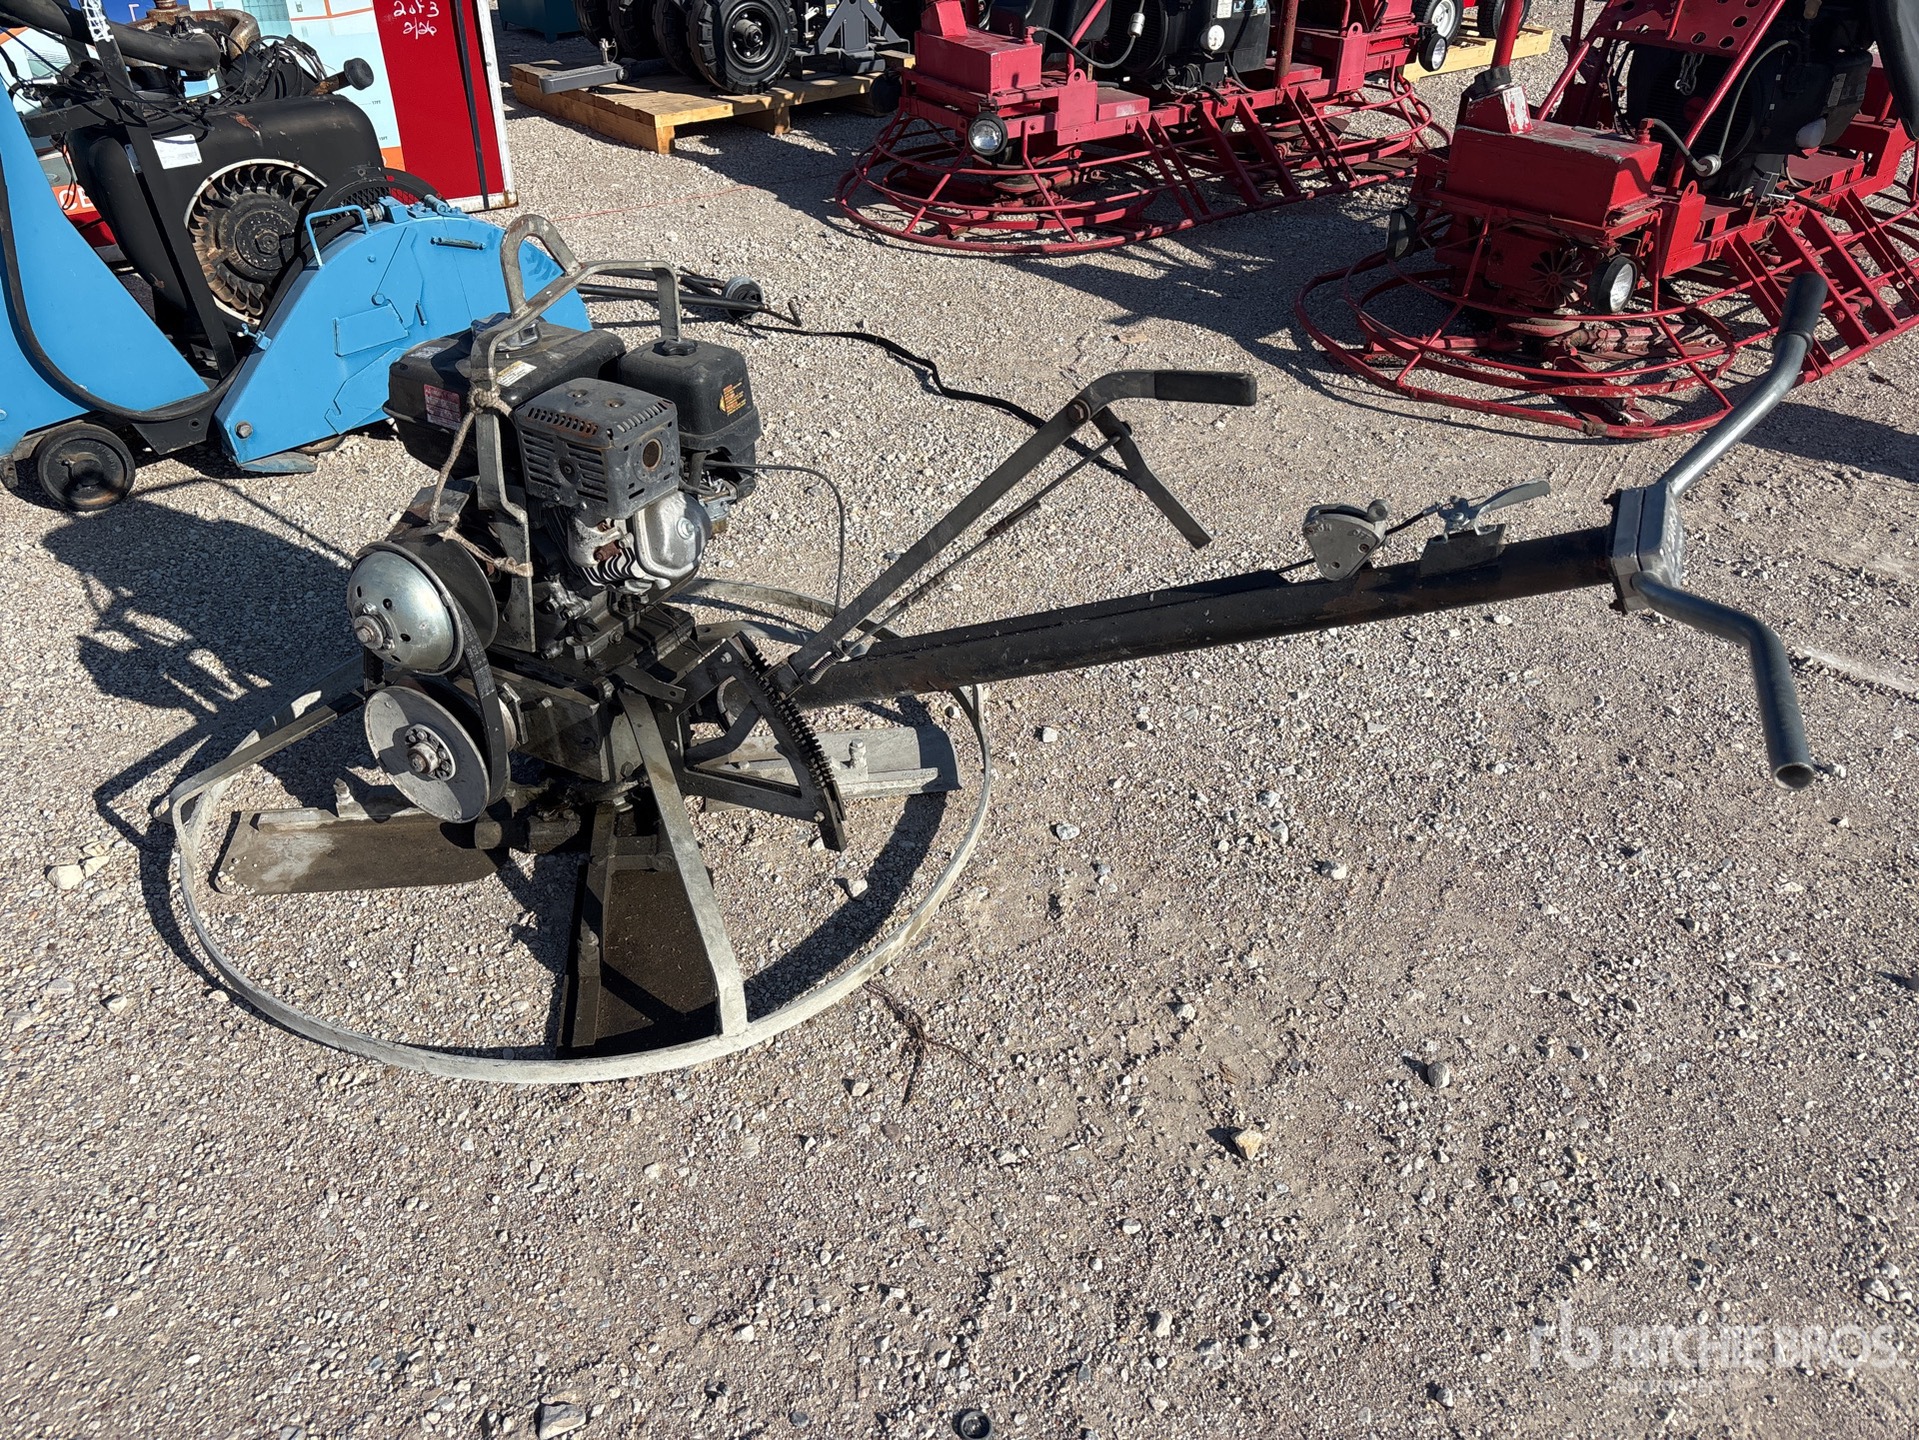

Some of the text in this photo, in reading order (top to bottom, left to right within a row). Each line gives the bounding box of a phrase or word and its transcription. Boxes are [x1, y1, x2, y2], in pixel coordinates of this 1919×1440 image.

[393, 0, 407, 17] 2
[426, 1, 440, 18] 3
[402, 16, 438, 40] 2/26
